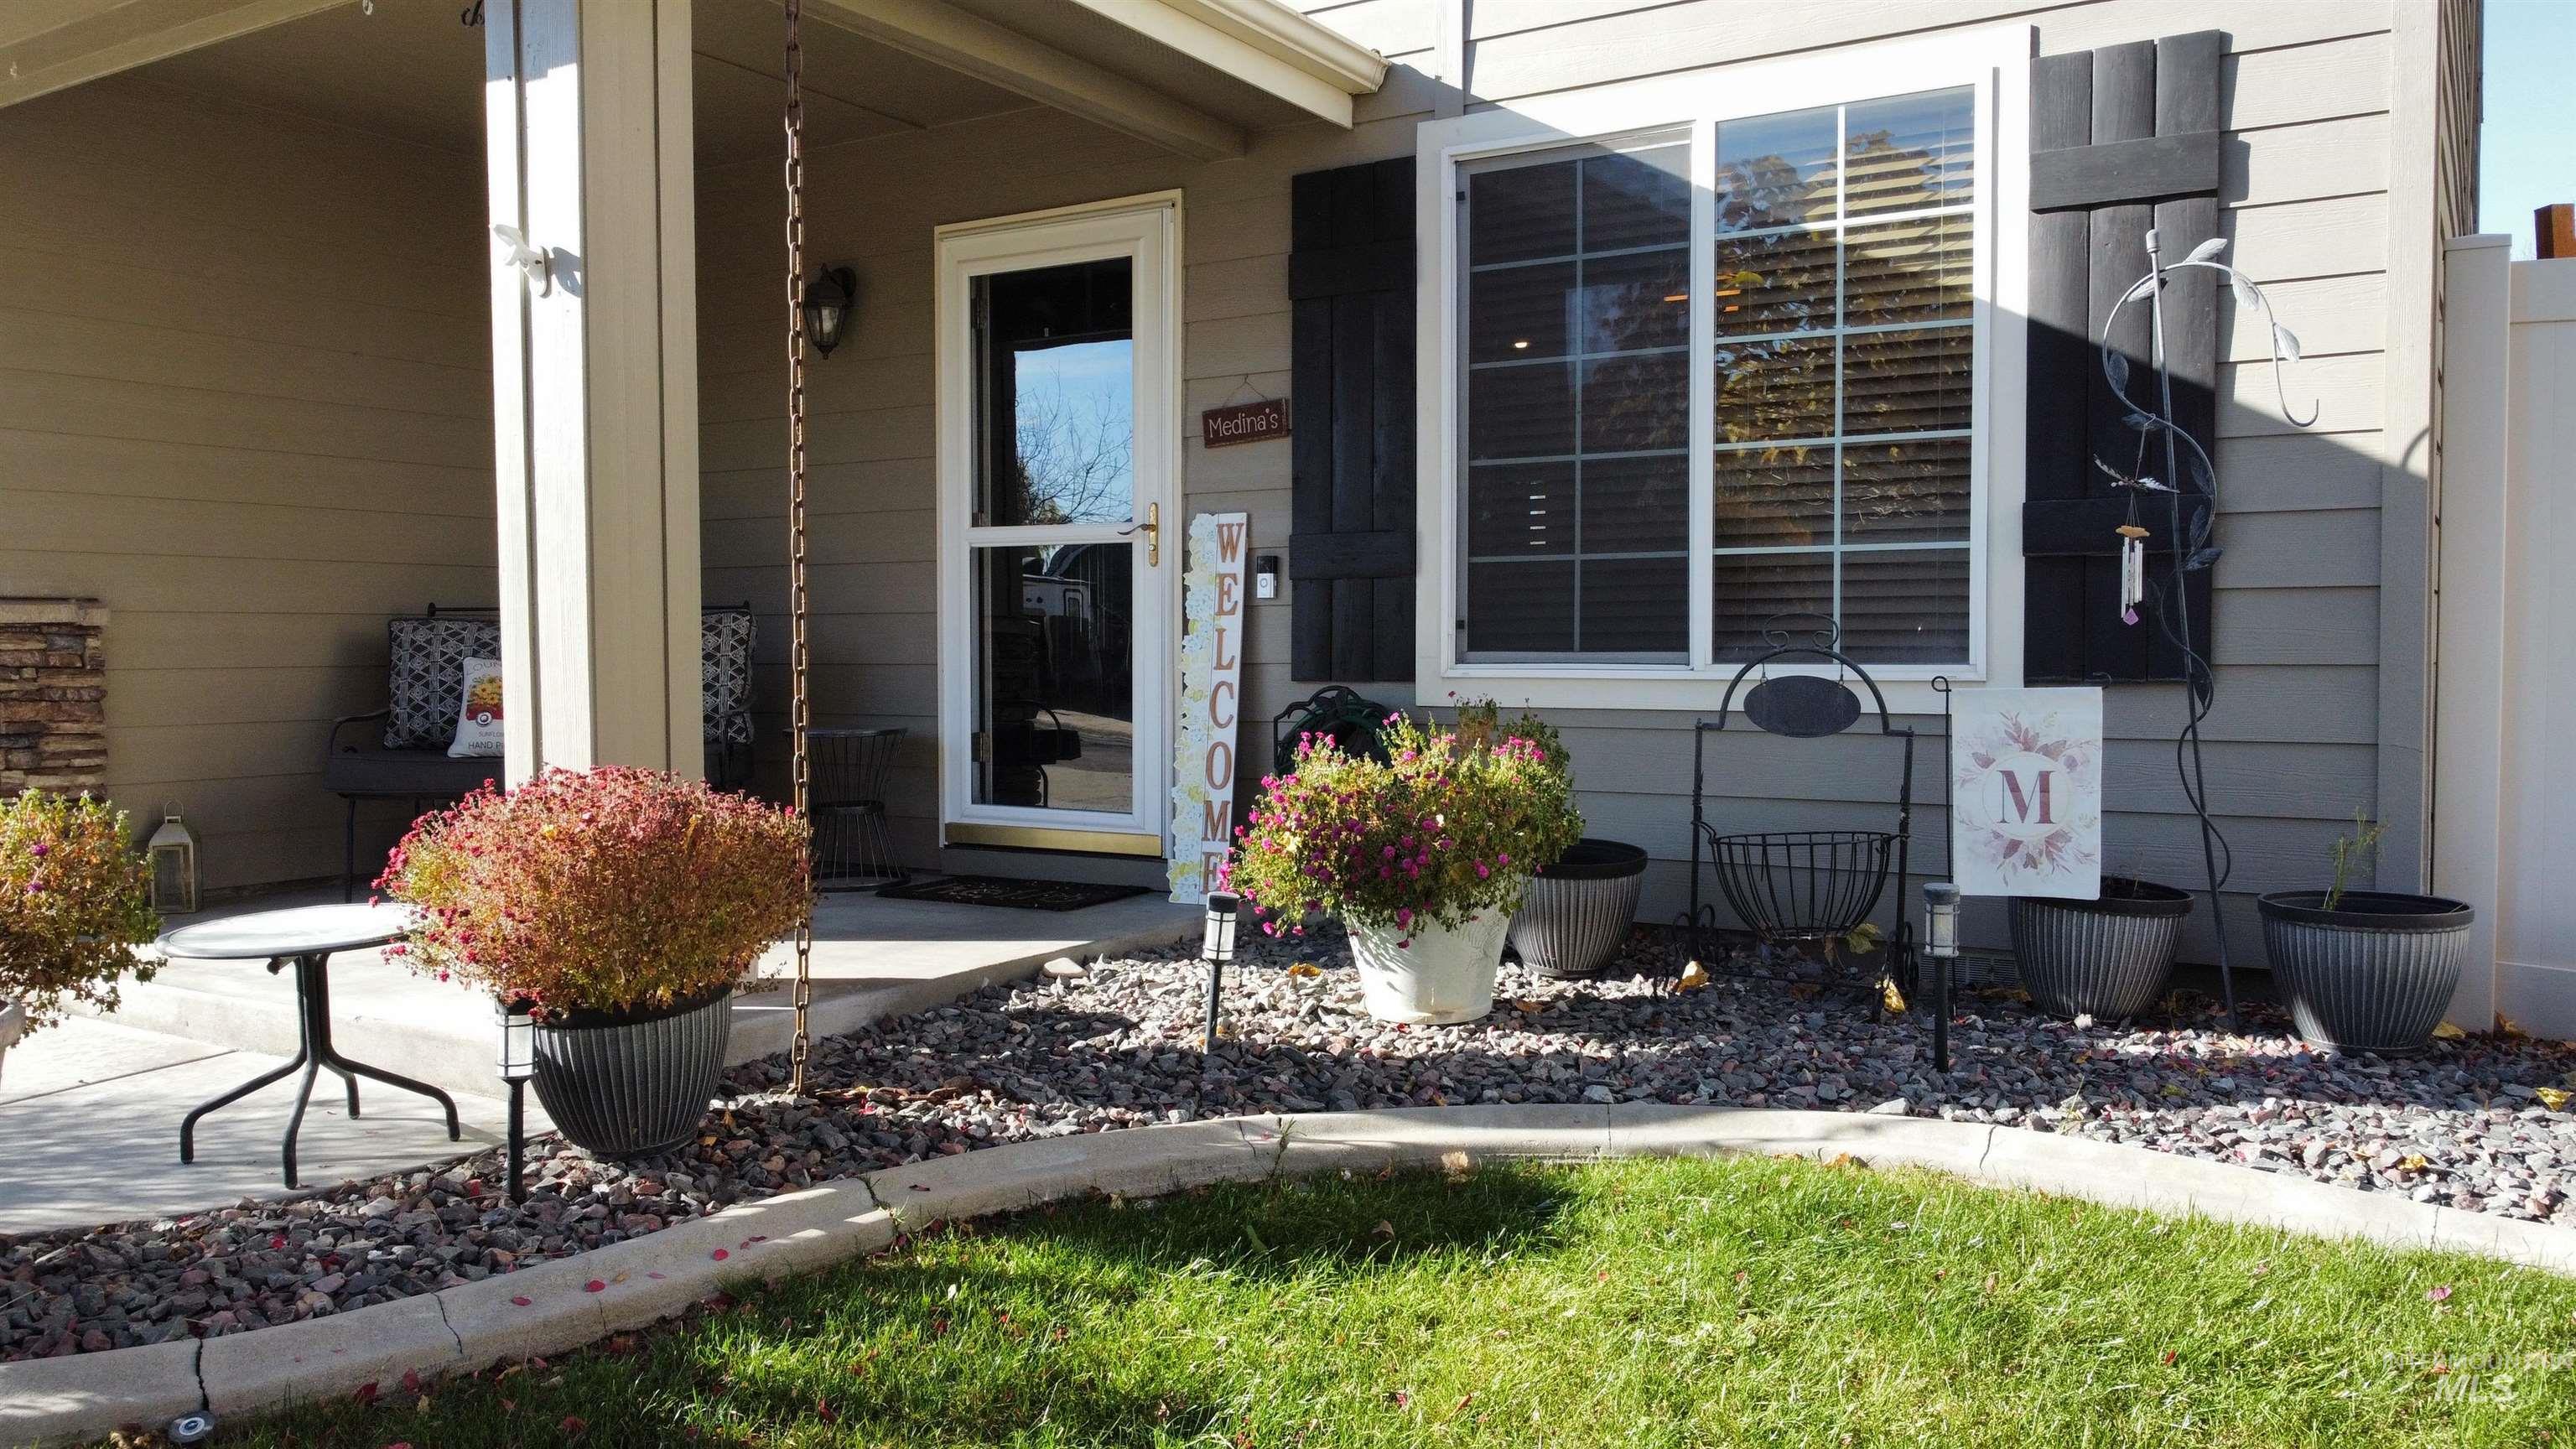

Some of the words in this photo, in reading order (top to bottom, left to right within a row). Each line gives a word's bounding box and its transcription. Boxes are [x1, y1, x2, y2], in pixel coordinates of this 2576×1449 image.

[1208, 408, 1279, 438] Medina's
[1202, 522, 1244, 895] WELCOME
[468, 740, 494, 750] HAND
[1996, 770, 2057, 824] M
